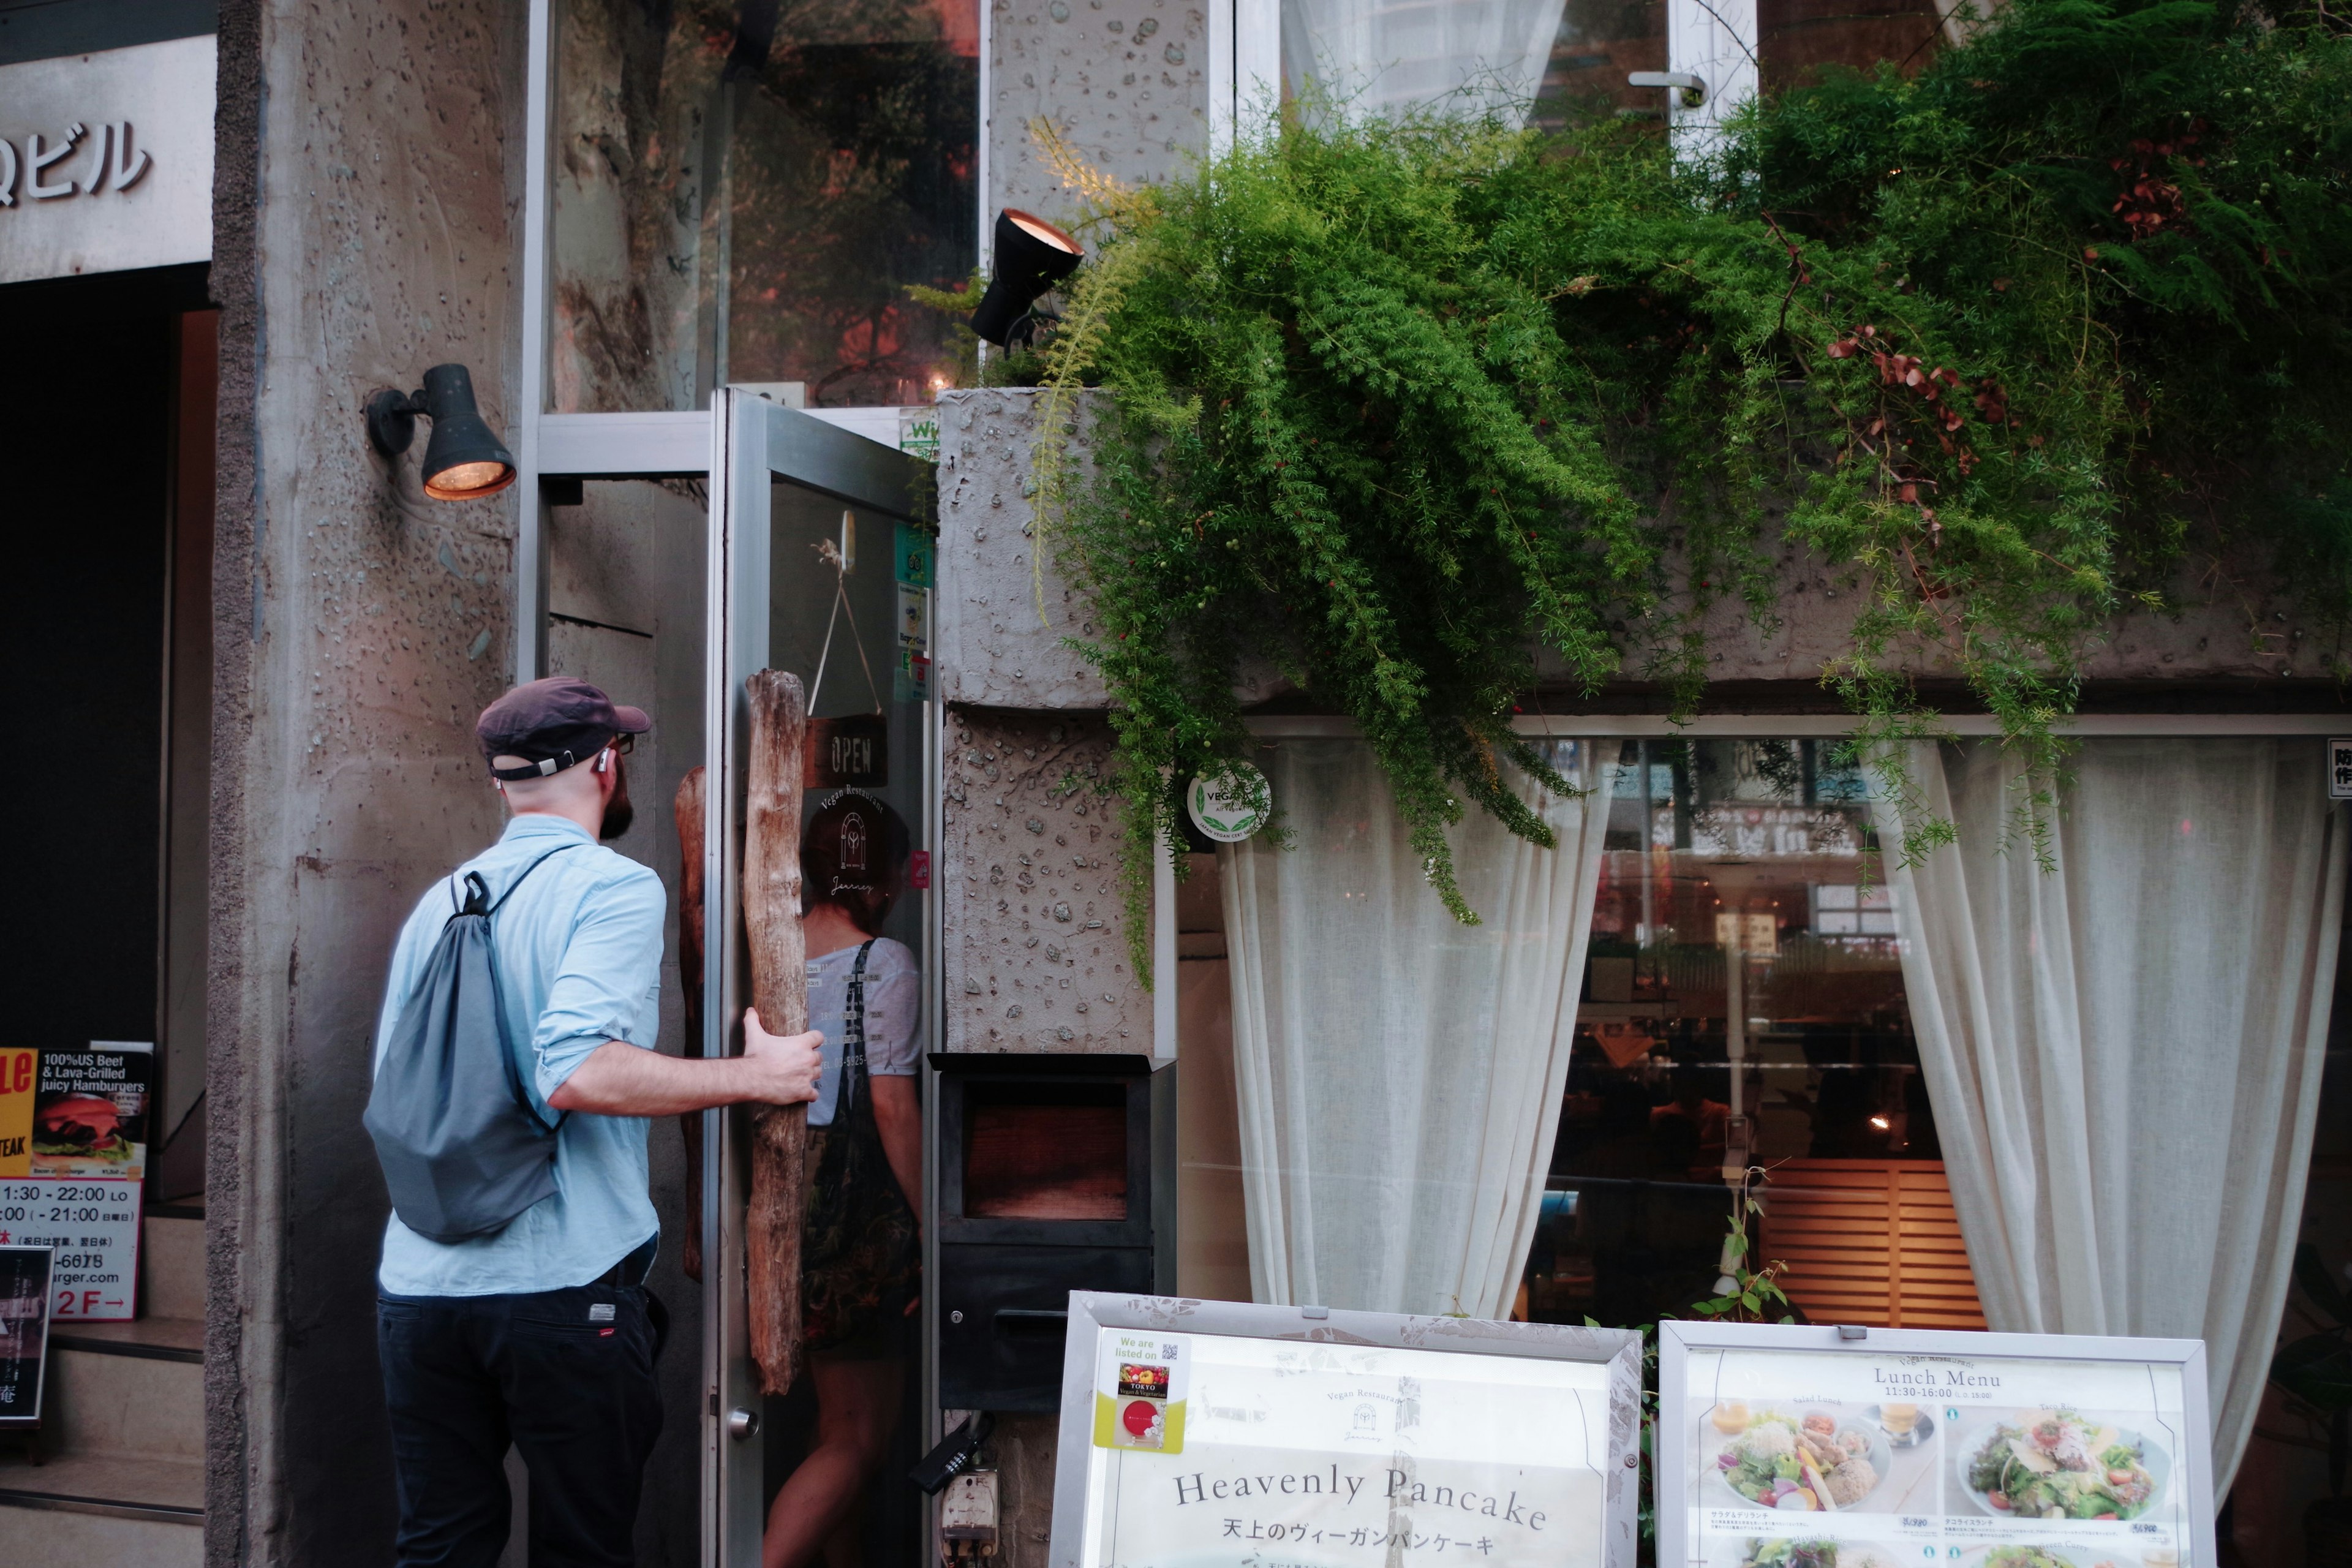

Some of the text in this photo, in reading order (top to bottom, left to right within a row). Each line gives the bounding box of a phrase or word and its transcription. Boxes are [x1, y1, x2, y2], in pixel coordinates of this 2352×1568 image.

[832, 736, 871, 773] OPEN
[821, 784, 884, 815] Vegan Restaurant
[1199, 822, 1212, 834] JAPAN
[44, 1054, 124, 1067] 100%US Beef
[42, 1066, 126, 1079] & Lava-Grilled
[40, 1079, 145, 1094] juicy Hamburgers
[58, 1187, 105, 1201] 22:00
[111, 1193, 127, 1202] LO
[50, 1208, 99, 1223] 21:00
[1121, 1337, 1136, 1346] We
[1115, 1348, 1142, 1359] listed
[1899, 1355, 1926, 1366] Vegan
[1874, 1368, 2002, 1387] Lunch Menu
[1327, 1389, 1404, 1407] Vegan Restaurant
[1885, 1387, 1952, 1398] 11:30-16:00
[1793, 1395, 1842, 1406] Salad Lunch
[2039, 1403, 2078, 1412] Taco Rice
[1172, 1463, 1547, 1531] Heavenly Pancake
[1223, 1518, 1494, 1555] 天上のヴィーガンパンケーキ
